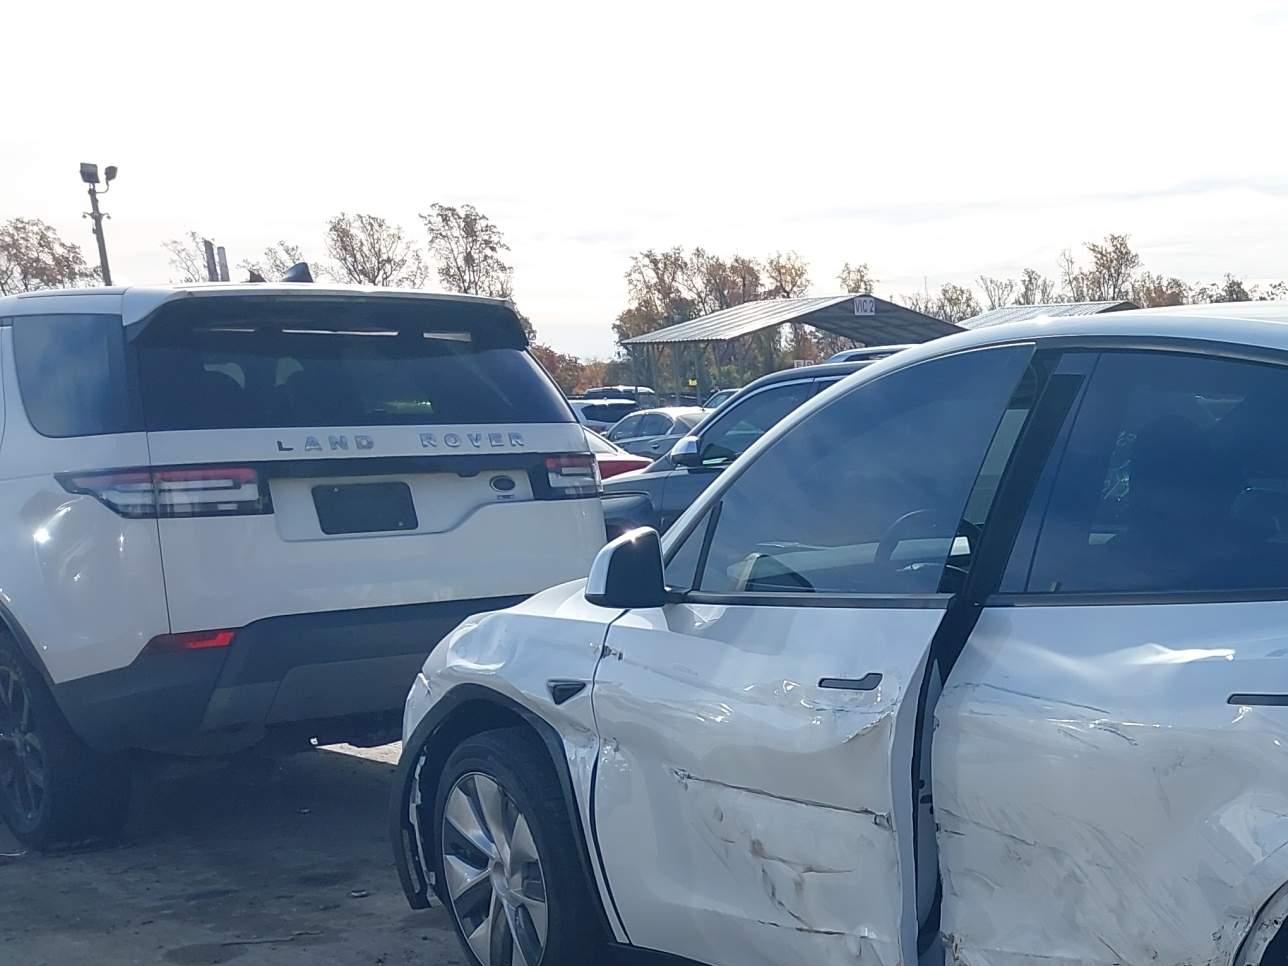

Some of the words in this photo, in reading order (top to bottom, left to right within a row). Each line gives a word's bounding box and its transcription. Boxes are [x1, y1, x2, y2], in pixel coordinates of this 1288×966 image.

[854, 299, 868, 313] VIC
[277, 434, 374, 452] LAND
[418, 431, 526, 449] ROVER
